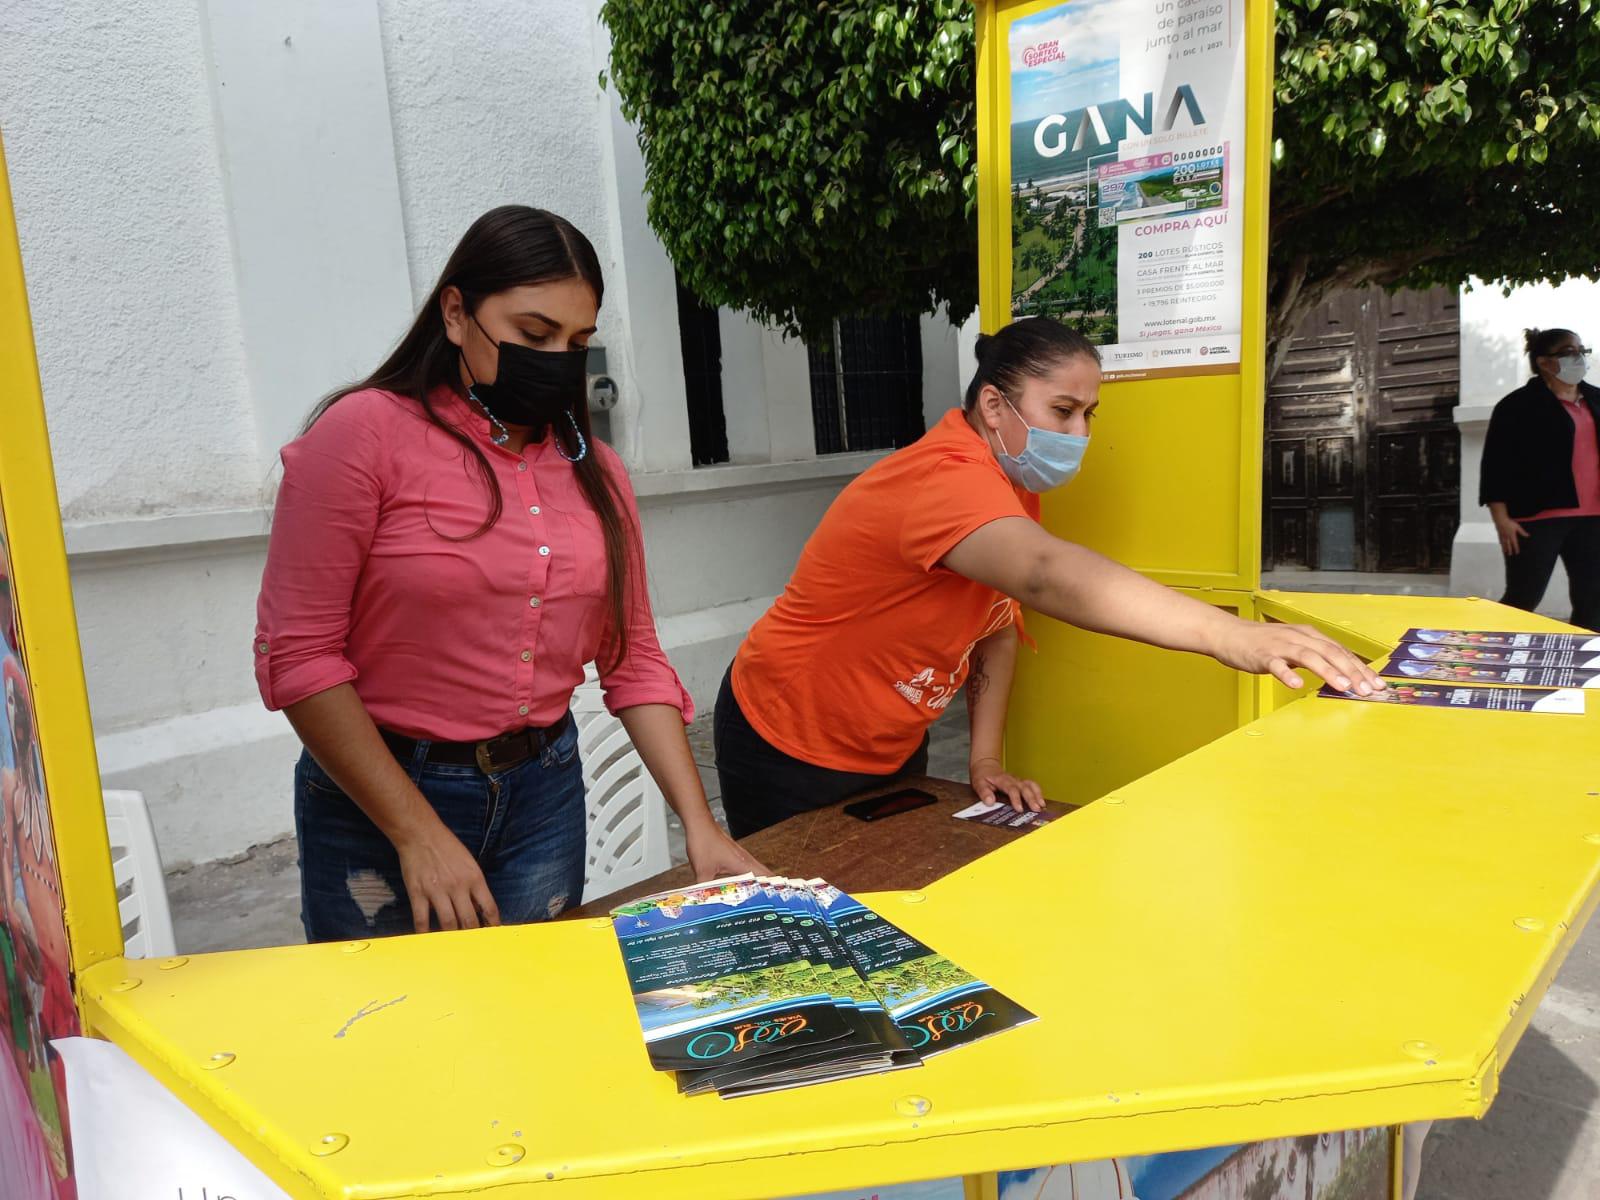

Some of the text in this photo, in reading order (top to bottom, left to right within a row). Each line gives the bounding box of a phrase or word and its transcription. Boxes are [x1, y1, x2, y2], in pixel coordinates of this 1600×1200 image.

[1158, 18, 1174, 30] de
[1145, 21, 1222, 52] junto al mar
[1028, 51, 1066, 67] ESPECIAL
[1034, 84, 1205, 158] GANA
[1173, 163, 1196, 176] 200
[1135, 211, 1228, 237] COMPRA AQUÍ
[1155, 248, 1180, 257] LOTES
[1137, 269, 1157, 277] CASA
[1160, 265, 1190, 275] FRENTE
